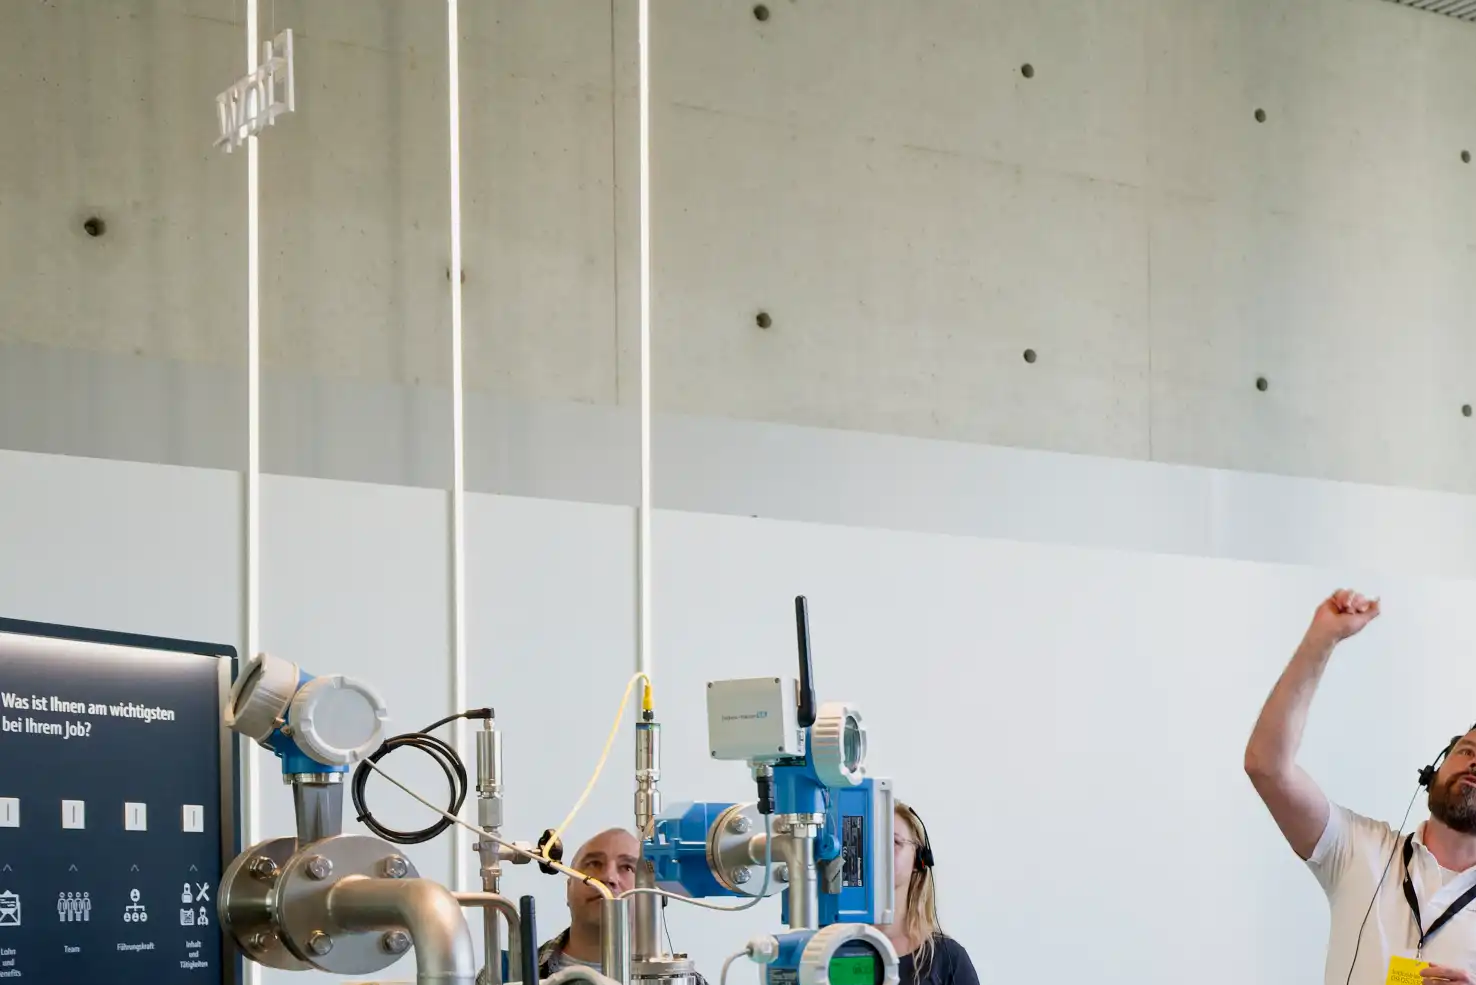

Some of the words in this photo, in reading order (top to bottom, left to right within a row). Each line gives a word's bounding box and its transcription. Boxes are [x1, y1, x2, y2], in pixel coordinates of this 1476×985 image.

[1, 692, 29, 709] Was
[32, 695, 48, 711] ist
[50, 696, 86, 713] Ihnen
[88, 703, 107, 715] am
[109, 702, 175, 723] wichtigsten
[2, 716, 22, 732] bei
[26, 717, 62, 735] Ihrem
[63, 721, 92, 739] Job?
[117, 942, 155, 952] Führungskraft
[186, 940, 201, 948] Inhalt
[64, 945, 80, 953] Team
[188, 950, 199, 958] und
[0, 969, 21, 977] enefits
